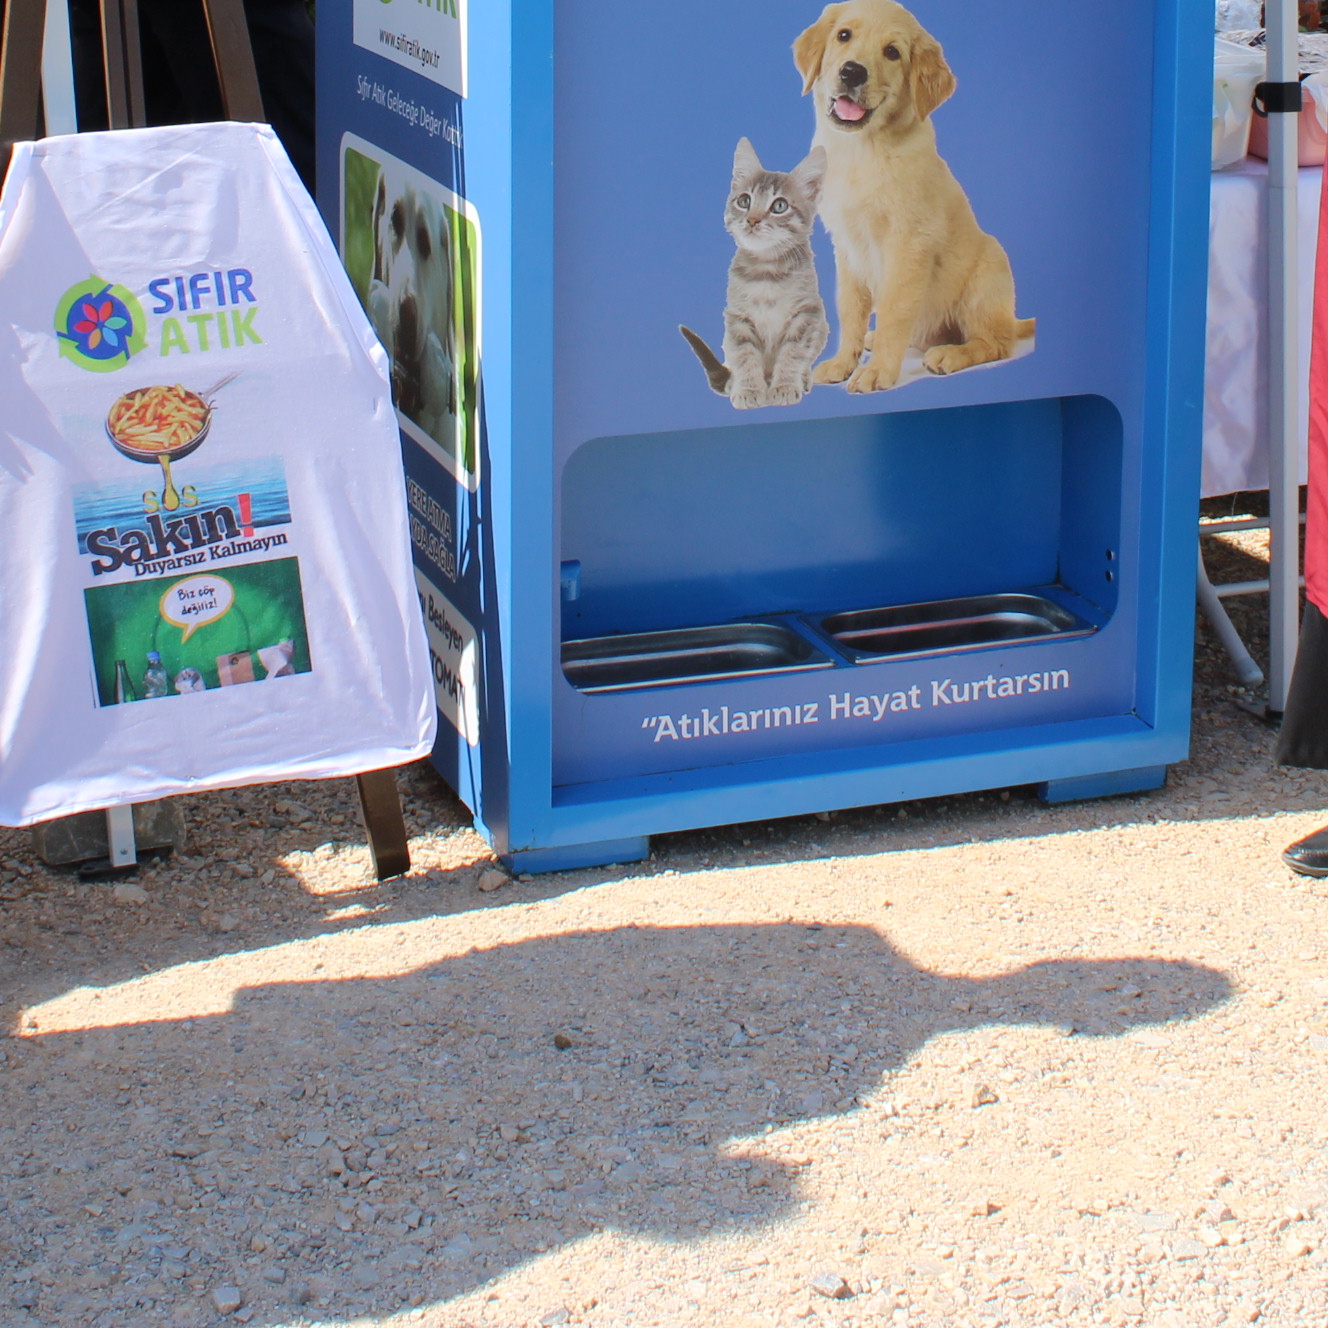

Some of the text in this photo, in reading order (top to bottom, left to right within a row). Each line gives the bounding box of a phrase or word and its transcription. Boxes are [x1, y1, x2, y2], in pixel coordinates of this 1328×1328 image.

[371, 82, 386, 107] Atık
[386, 89, 419, 126] Geleceğe
[419, 106, 442, 138] Değer
[148, 268, 258, 316] SIFIR
[159, 306, 263, 358] ATIK
[86, 492, 255, 576] Sakın!
[133, 533, 288, 577] Duyarsız Kalmayın
[177, 585, 216, 601] Biz çöp
[181, 597, 218, 616] değiliz!
[427, 591, 464, 654] Besleyen
[828, 683, 922, 723] Hayat
[930, 668, 1071, 707] Kurtarsın
